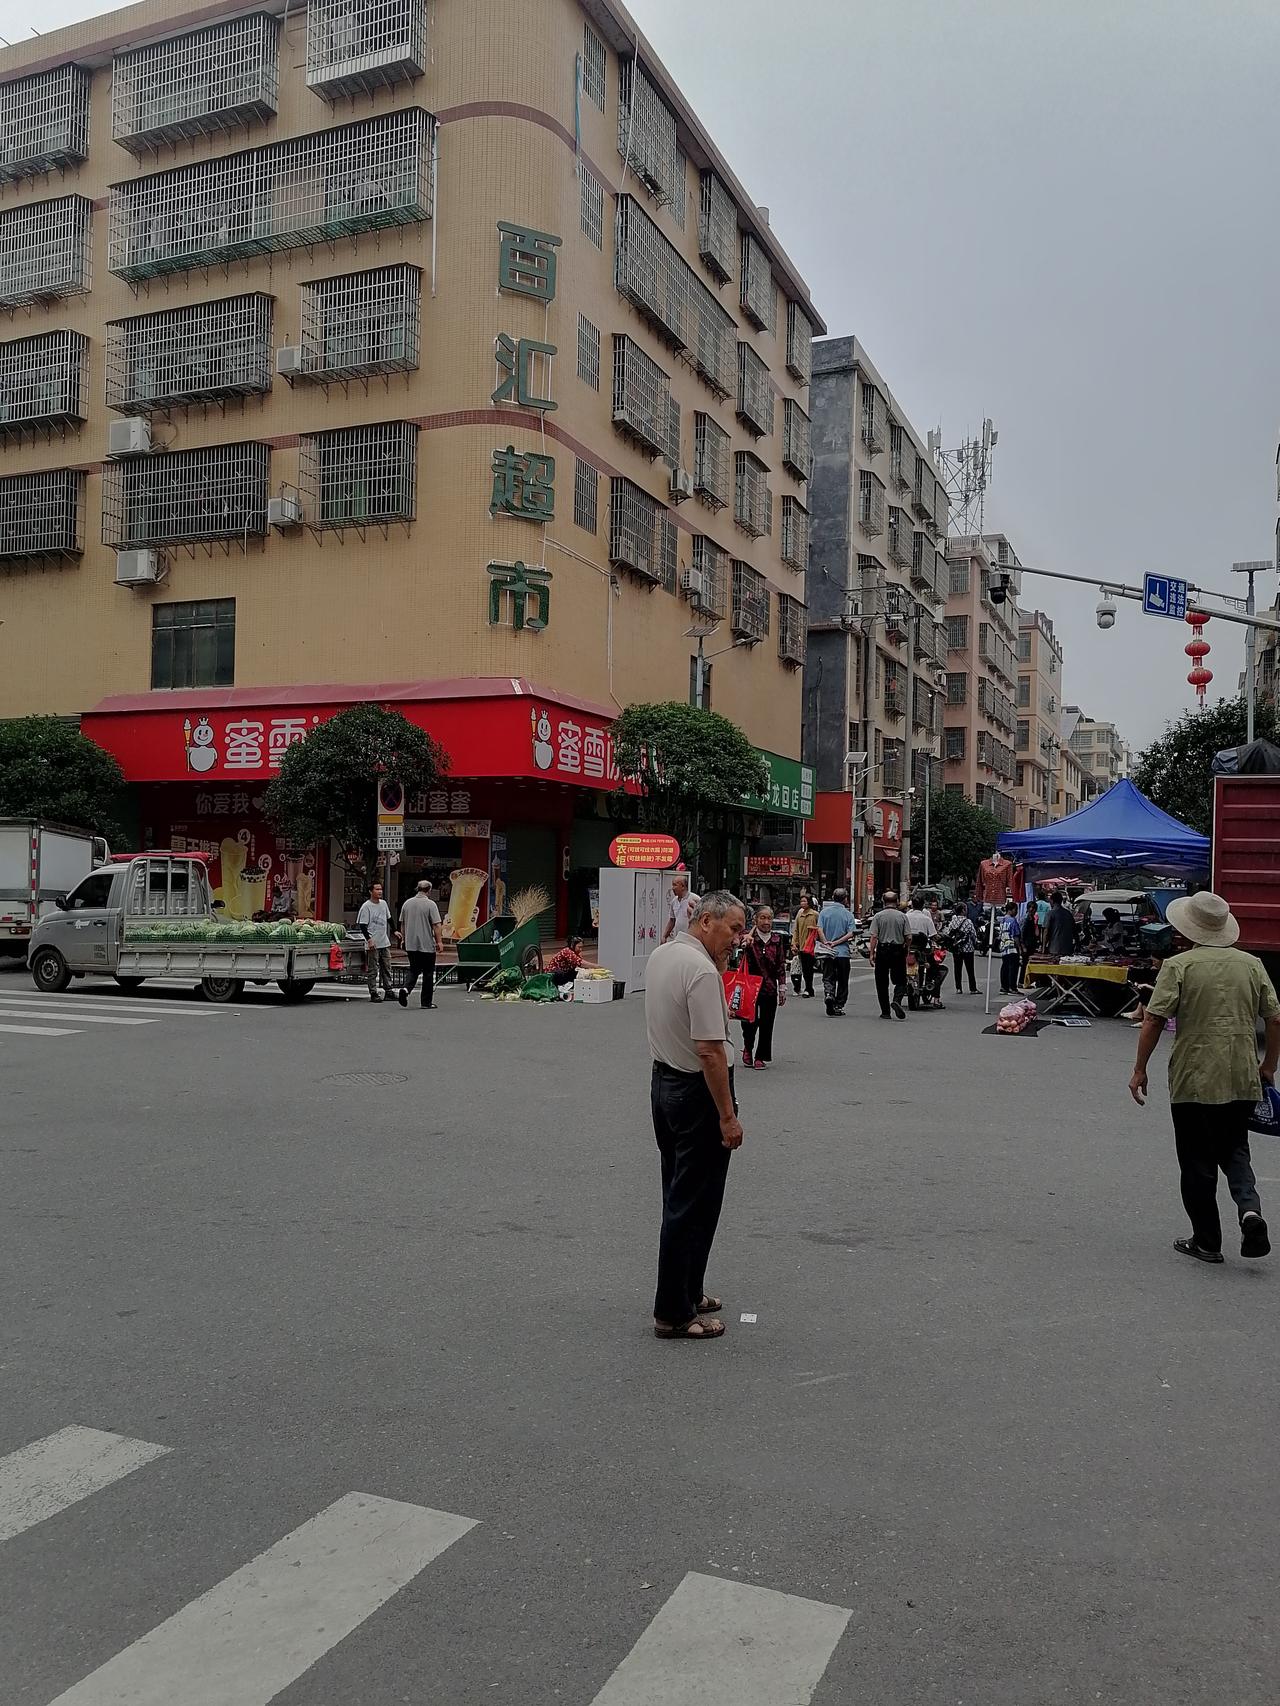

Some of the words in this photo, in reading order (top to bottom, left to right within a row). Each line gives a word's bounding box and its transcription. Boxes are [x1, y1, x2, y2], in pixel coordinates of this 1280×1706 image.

[486, 220, 563, 631] 百汇超市
[1170, 581, 1185, 594] 交通
[1171, 592, 1184, 604] 违法
[1169, 604, 1183, 616] 监控
[224, 717, 319, 770] 蜜雪
[195, 791, 250, 814] 你爱我
